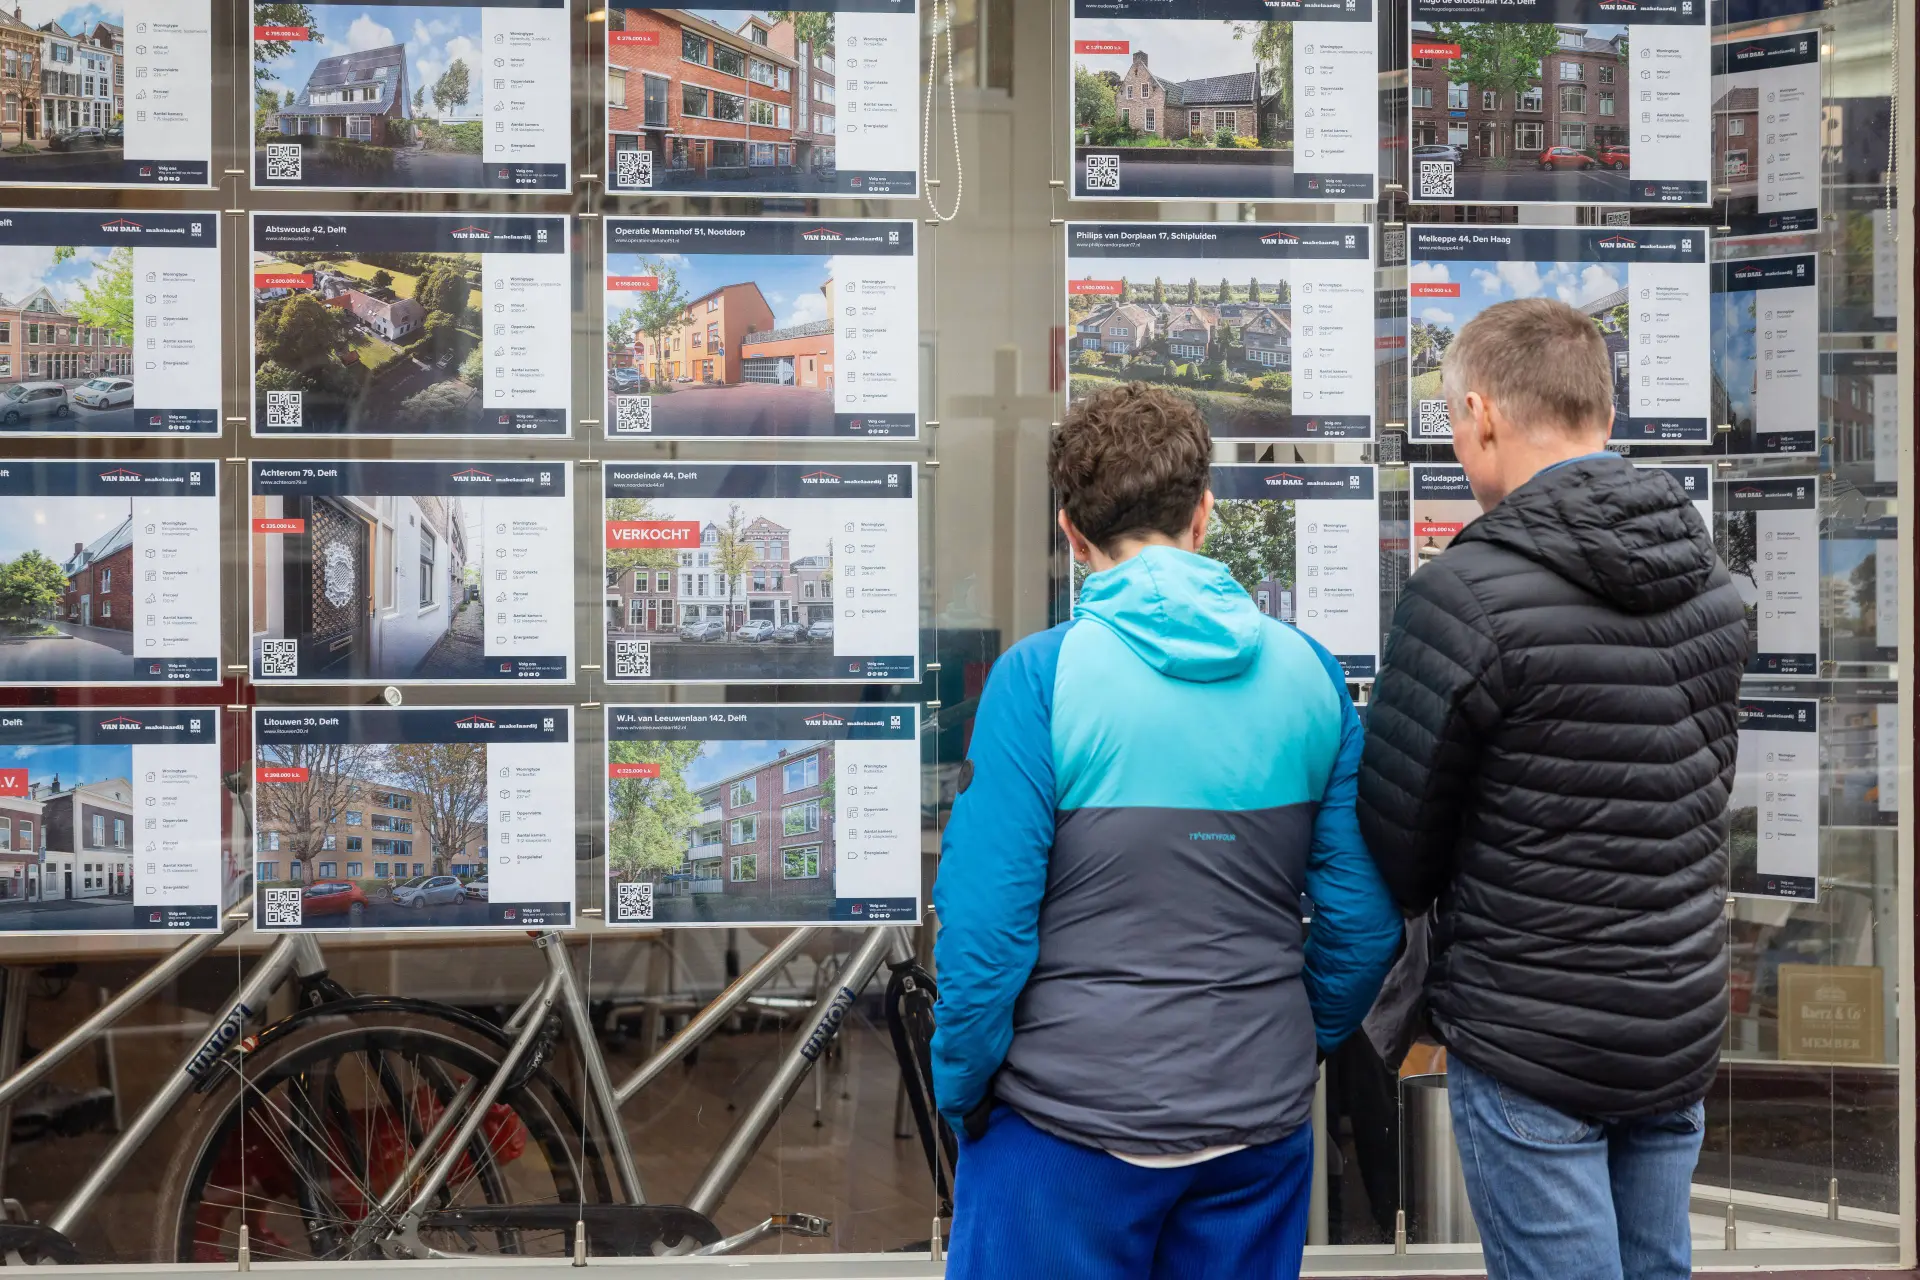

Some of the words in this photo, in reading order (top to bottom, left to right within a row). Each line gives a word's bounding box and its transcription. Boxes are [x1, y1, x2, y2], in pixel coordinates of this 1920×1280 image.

[312, 226, 326, 234] 42,
[615, 227, 650, 236] Operatie
[694, 228, 706, 236] 51,
[707, 228, 746, 237] Nootdorp
[1076, 232, 1103, 240] Philips
[1120, 232, 1157, 240] Dorplaan
[1158, 232, 1170, 240] 17,
[1171, 232, 1217, 241] Schipluiden
[1418, 235, 1457, 244] Melkeppe
[1458, 235, 1471, 243] 44,
[1490, 236, 1511, 245] Haag
[302, 469, 316, 477] 79,
[662, 472, 676, 480] 44,
[1422, 474, 1464, 483] Goudappel
[612, 528, 690, 540] VERKOCHT
[303, 718, 317, 726] 30,
[709, 714, 726, 722] 142,
[1834, 1005, 1844, 1020] &
[804, 989, 854, 1056] UNION
[188, 1006, 247, 1075] UNION
[1801, 1038, 1860, 1049] MEMBER
